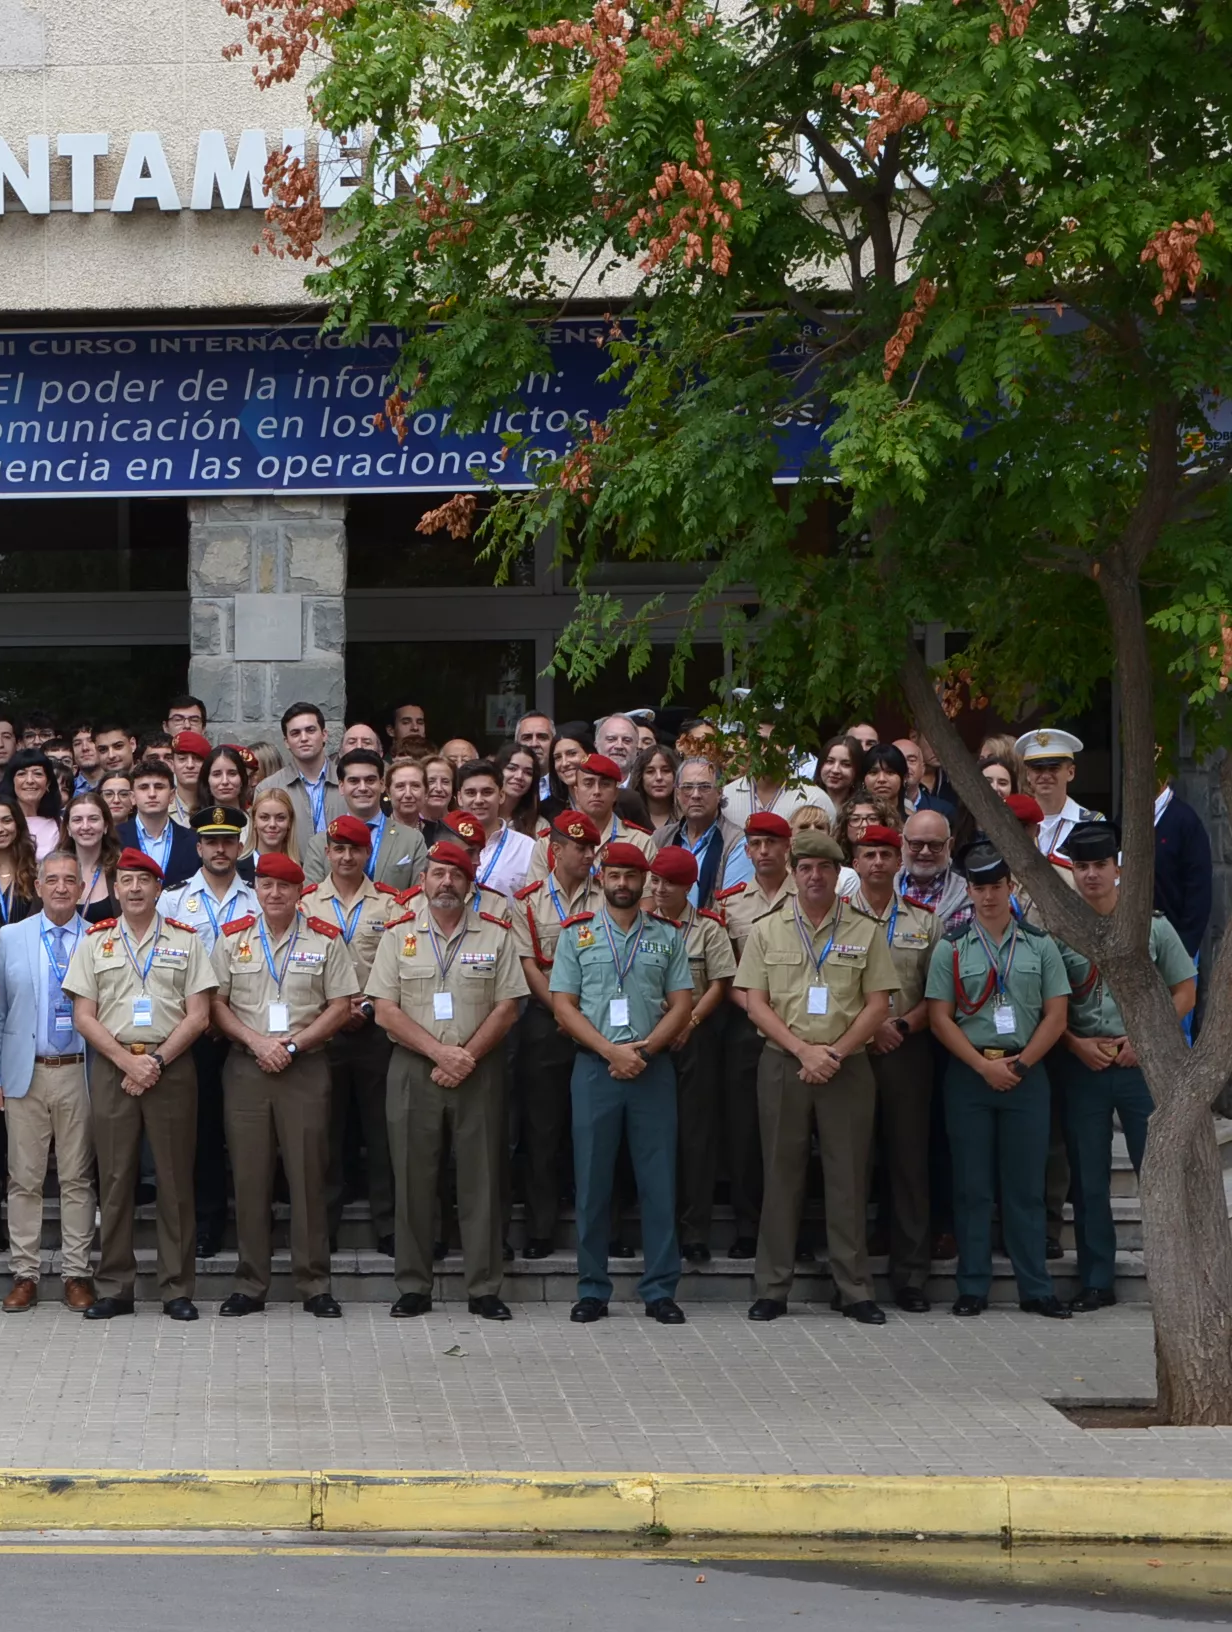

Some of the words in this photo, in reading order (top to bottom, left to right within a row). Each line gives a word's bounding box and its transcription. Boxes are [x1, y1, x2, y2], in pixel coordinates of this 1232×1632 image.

[28, 337, 137, 356] CURSO
[37, 370, 164, 412] poder
[177, 368, 228, 402] de
[243, 368, 277, 401] la
[256, 414, 304, 439] en
[319, 406, 376, 438] los
[125, 456, 174, 481] en
[188, 448, 242, 481] las
[256, 445, 506, 487] operaciones
